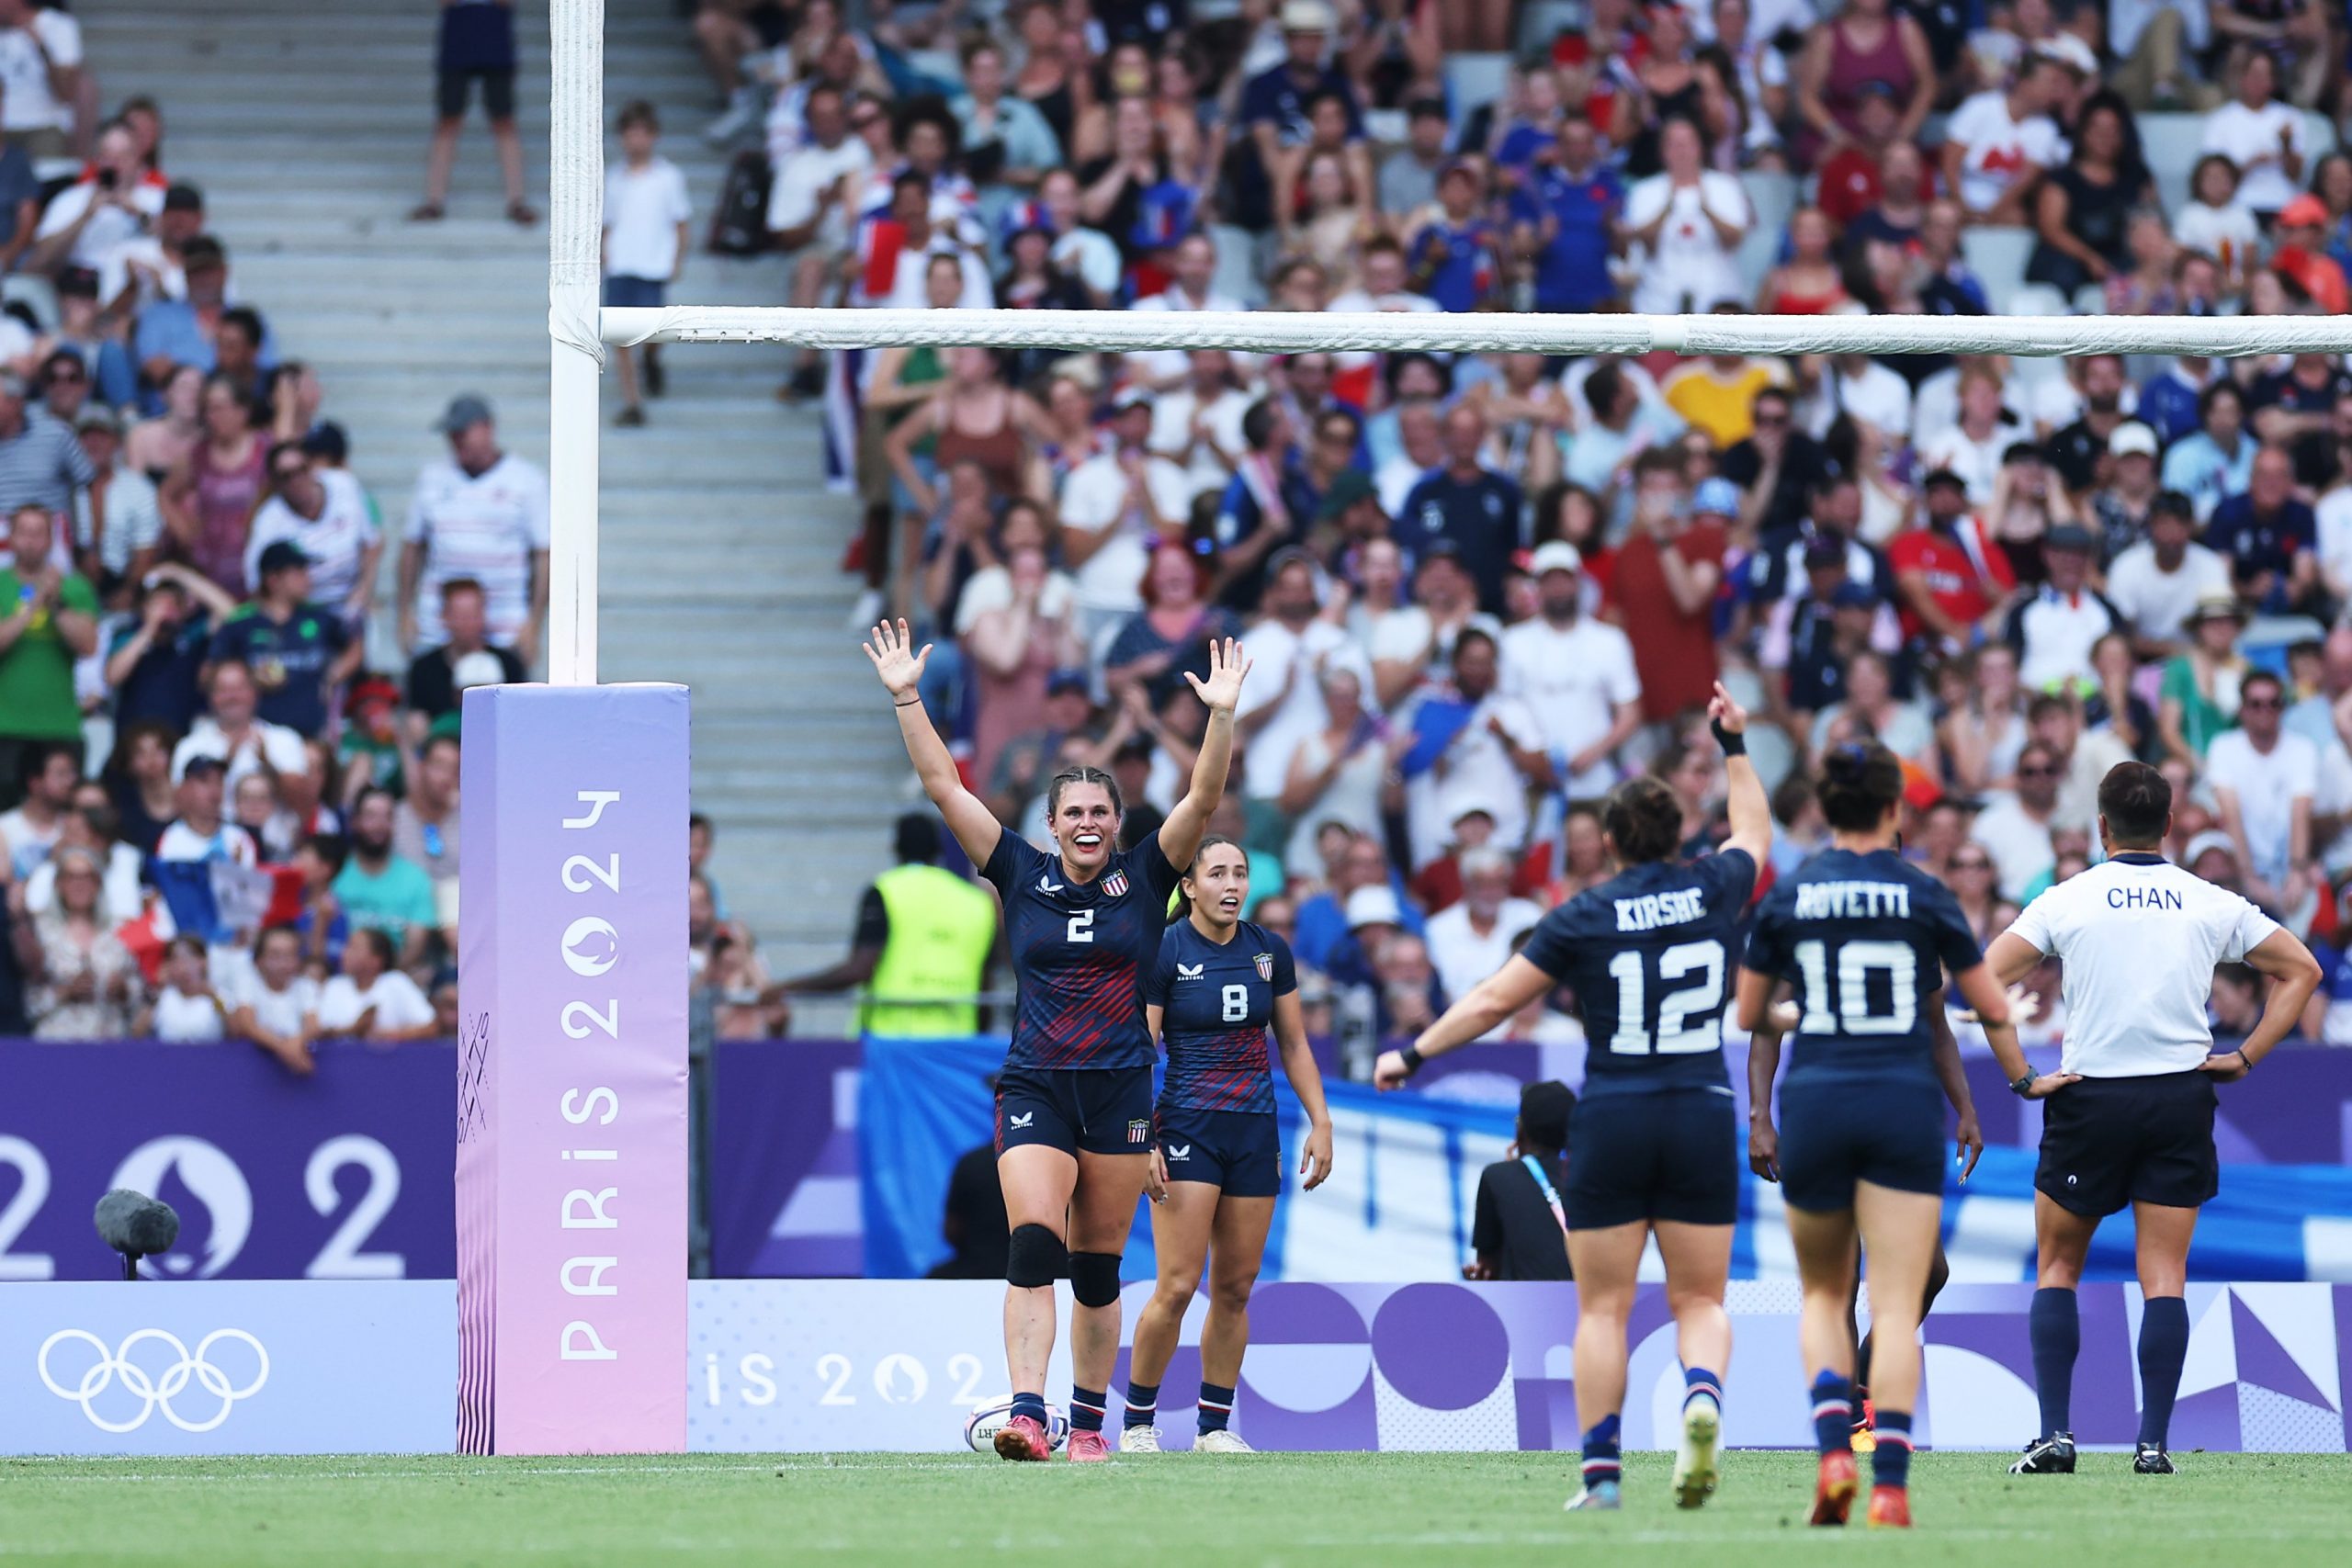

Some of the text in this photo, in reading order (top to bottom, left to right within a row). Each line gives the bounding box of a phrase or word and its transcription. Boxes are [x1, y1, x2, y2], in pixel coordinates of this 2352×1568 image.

[560, 790, 621, 1040] 2024
[1613, 887, 1706, 931] KIRSHE
[1794, 881, 1909, 919] ROVETTI
[2108, 887, 2182, 910] CHAN
[1067, 909, 1094, 942] 2
[1222, 984, 1248, 1021] 8
[1609, 939, 1724, 1055] 12
[1793, 939, 1917, 1035] 10
